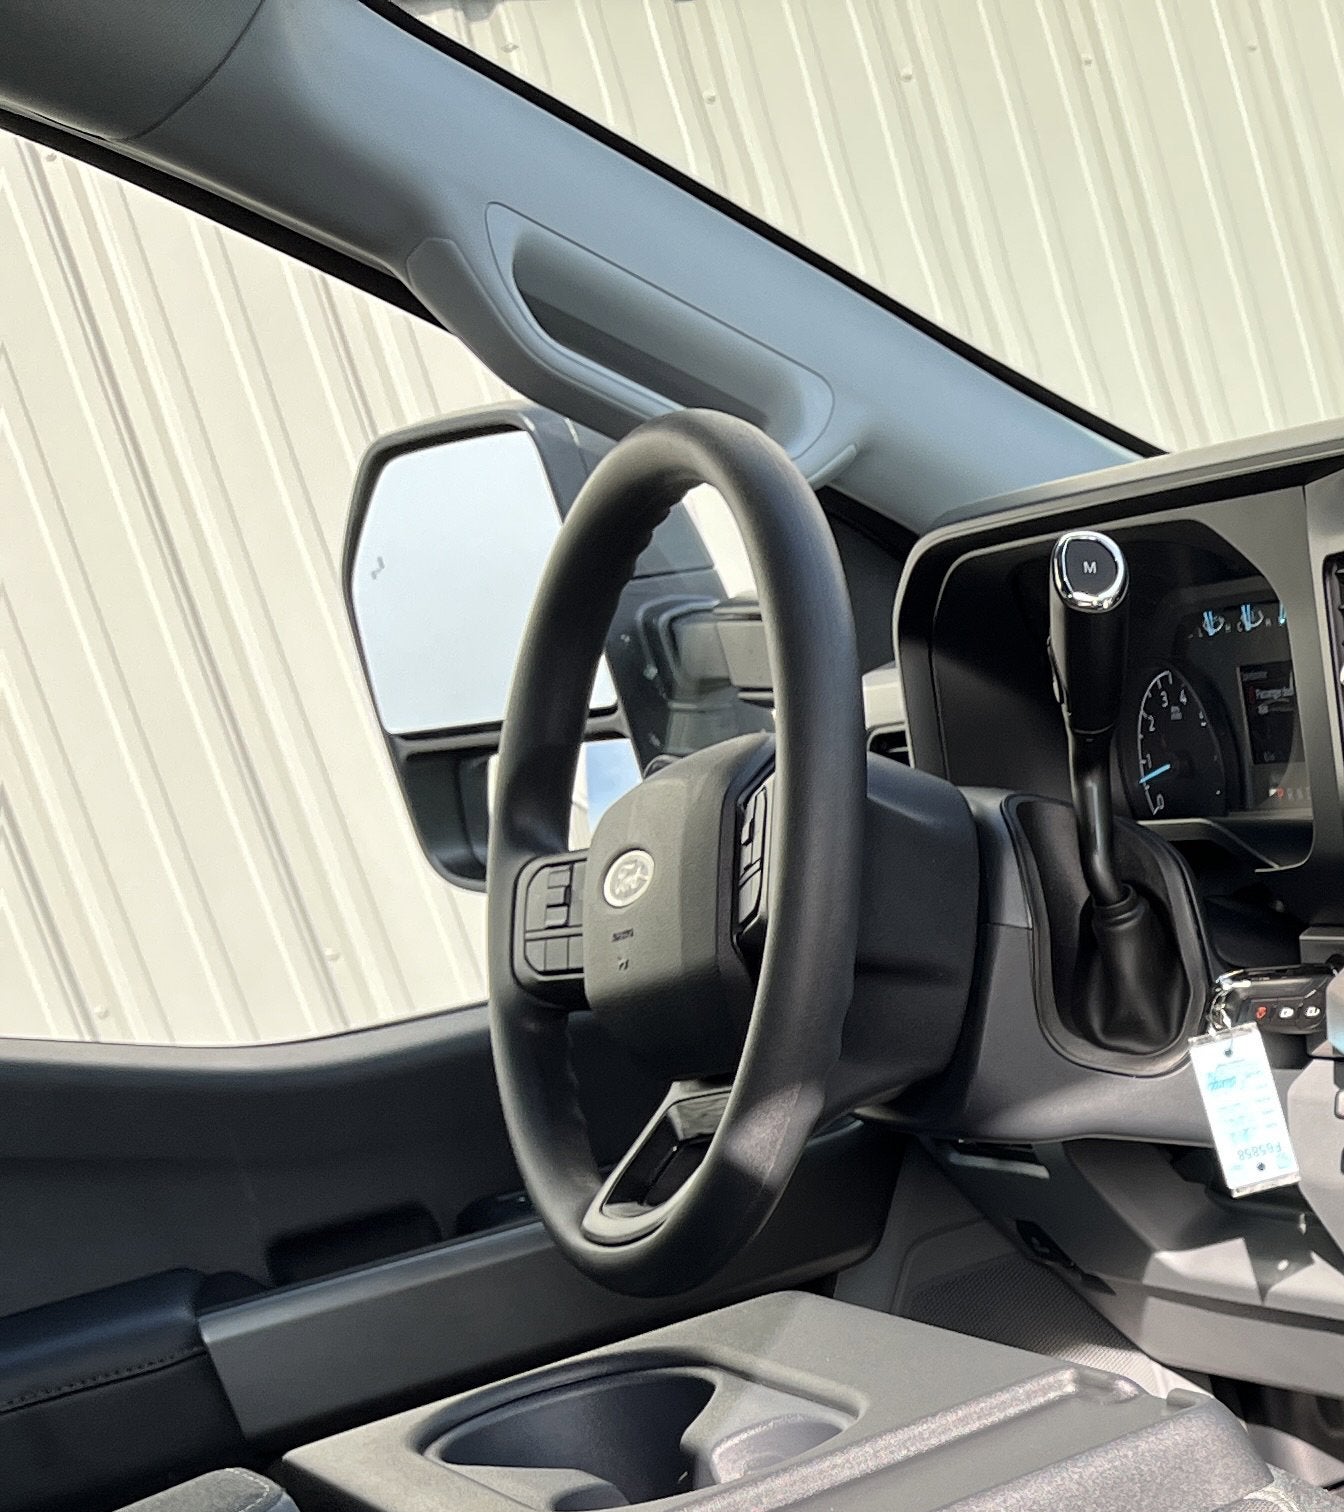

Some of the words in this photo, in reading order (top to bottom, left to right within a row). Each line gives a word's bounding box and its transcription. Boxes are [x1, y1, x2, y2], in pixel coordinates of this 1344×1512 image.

[1083, 561, 1097, 574] M
[1160, 690, 1169, 708] 3
[1179, 688, 1188, 706] 4
